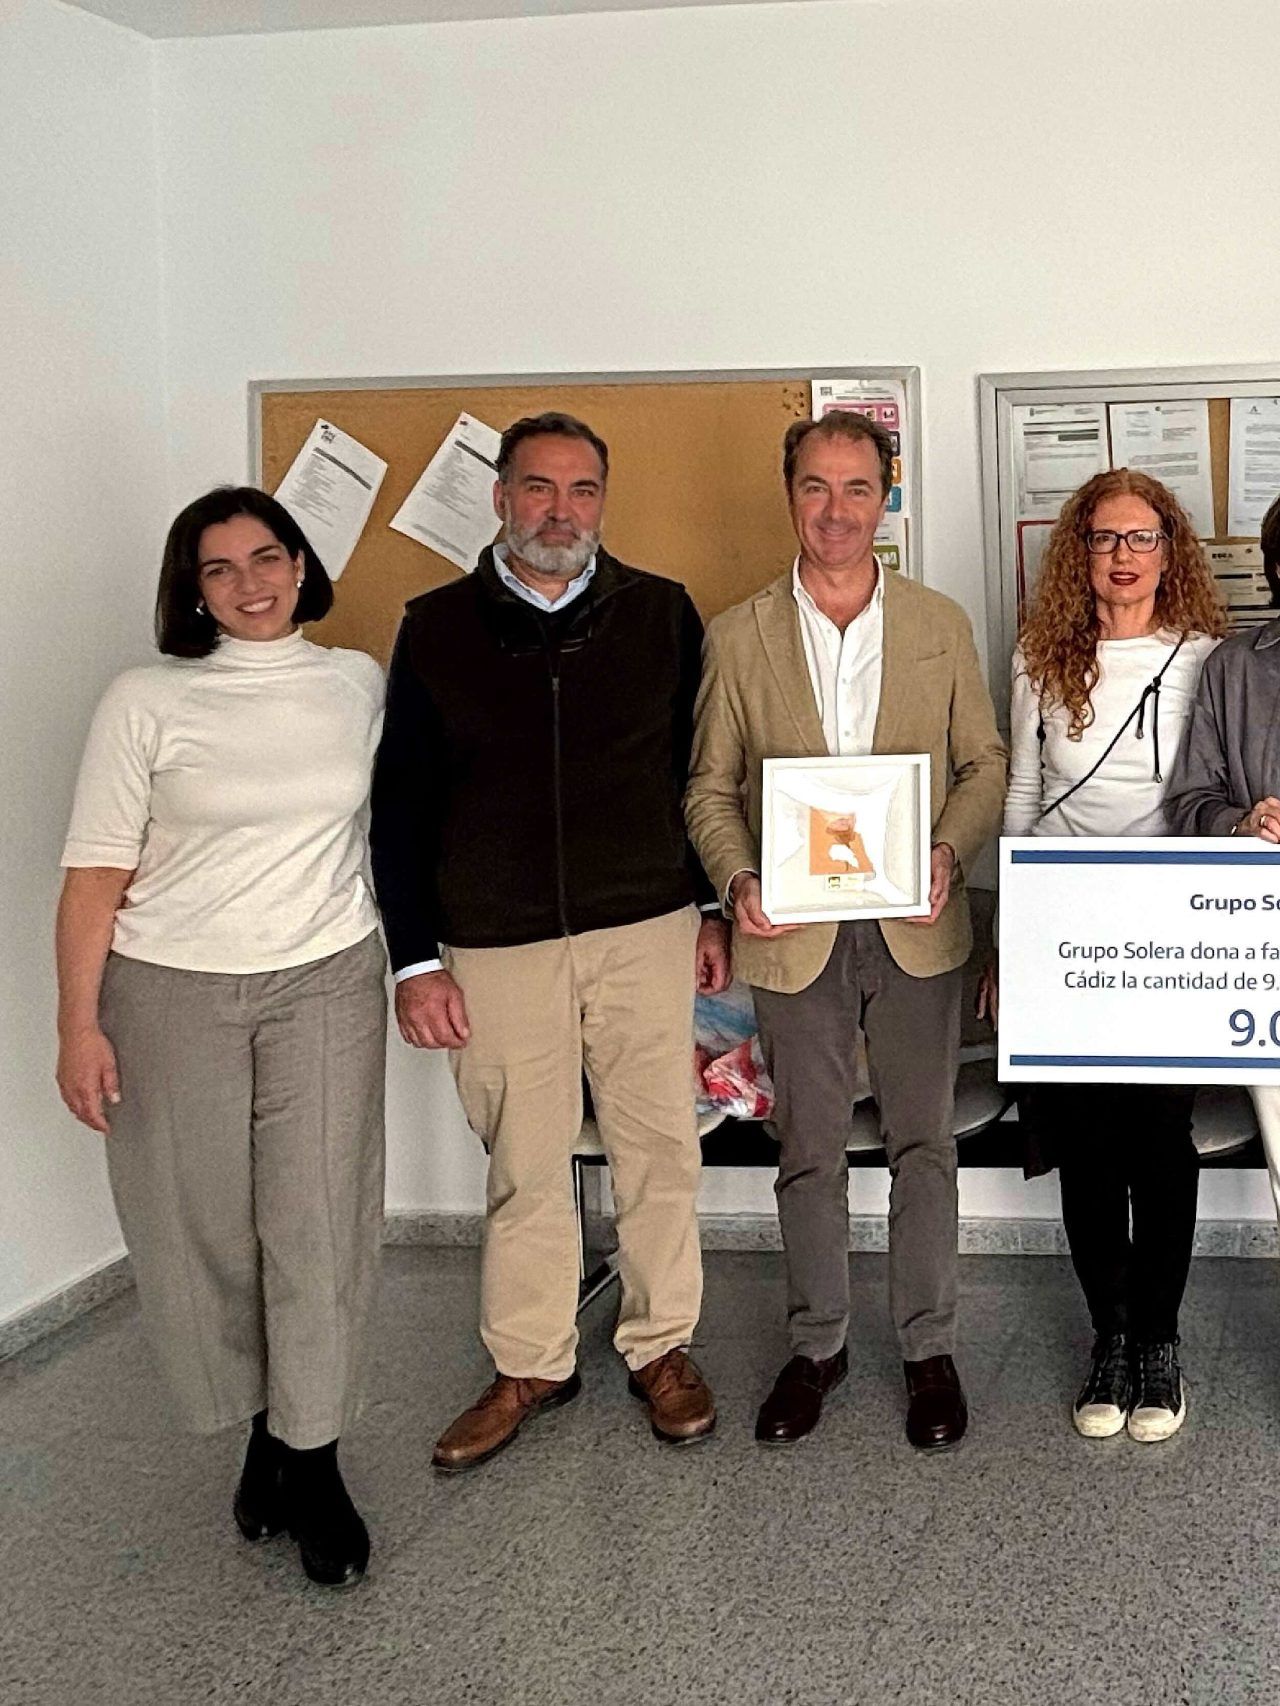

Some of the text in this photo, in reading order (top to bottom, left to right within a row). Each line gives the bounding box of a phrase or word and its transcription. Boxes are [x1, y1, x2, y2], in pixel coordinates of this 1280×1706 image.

[1189, 893, 1257, 915] Grupo
[1058, 941, 1119, 964] Grupo
[1123, 940, 1185, 960] Solera
[1190, 940, 1239, 960] dona
[1244, 947, 1256, 960] a
[1064, 969, 1117, 989] Cádiz
[1121, 970, 1138, 989] la
[1143, 971, 1228, 990] cantidad
[1233, 971, 1258, 991] de
